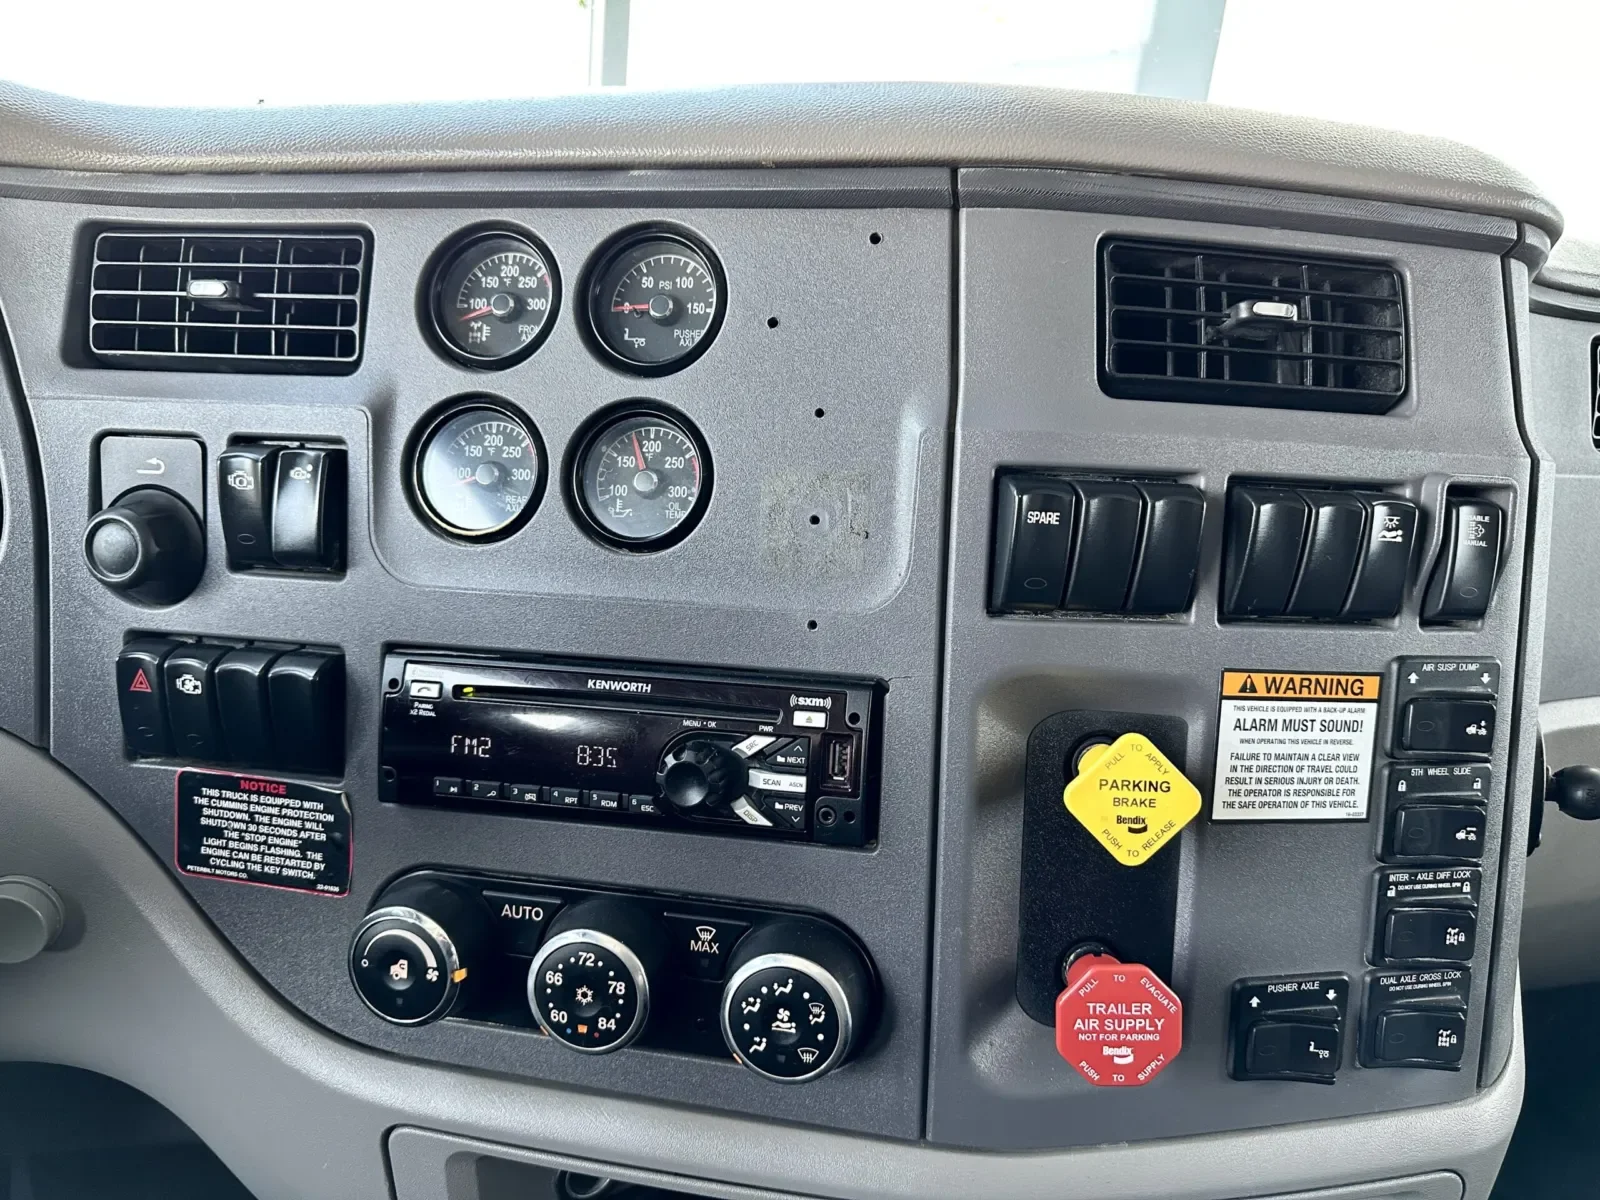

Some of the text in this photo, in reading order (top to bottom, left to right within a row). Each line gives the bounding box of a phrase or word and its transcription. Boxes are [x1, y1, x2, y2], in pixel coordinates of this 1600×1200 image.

[500, 265, 519, 277] 200
[481, 276, 498, 288] 150
[518, 276, 537, 289] 250
[641, 277, 654, 289] 50
[659, 280, 672, 290] PSI
[675, 277, 694, 289] 100
[469, 299, 487, 310] 100
[527, 299, 546, 311] 300
[687, 302, 705, 314] 150
[484, 435, 503, 447] 200
[642, 441, 661, 452] 200
[464, 446, 482, 457] 150
[502, 446, 521, 458] 250
[616, 456, 635, 468] 150
[664, 457, 684, 469] 250
[511, 469, 530, 480] 300
[609, 485, 628, 496] 100
[668, 486, 687, 498] 300
[668, 502, 681, 510] OIL
[1027, 511, 1060, 525] SPARE
[1422, 663, 1480, 672] AIR SUSP DUMP
[587, 679, 651, 693] KENWORTH
[1264, 676, 1365, 696] WARNING
[683, 719, 717, 728] MENU OK
[759, 725, 774, 733] PWR
[1233, 718, 1364, 733] ALARM MUST SOUND!
[451, 735, 492, 758] FM2
[787, 756, 806, 764] NEXT
[1104, 743, 1171, 776] PULL TO APPLY
[1230, 752, 1360, 761] FAILURE TO MAINTAIN CLEAR VIEW
[1230, 764, 1358, 774] IN THE DIRECTION OF TRAVEL COULD
[1411, 767, 1472, 777] 5TH WHEEL SLIDE
[762, 778, 782, 786] SCAN
[1099, 779, 1171, 793] PARKING
[1224, 776, 1360, 785] RESULT IN SERIOUS INJURY OR DEATH.
[240, 780, 287, 795] NOTICE
[1228, 788, 1356, 797] THE OPERATOR IS RESPONSIBLE FOR
[201, 787, 324, 811] THIS TRUCK IS EQUIPPED WITH
[564, 796, 578, 804] RPT
[1112, 797, 1157, 808] BRAKE
[1222, 800, 1359, 809] THE SAFE OPERATION OF THIS VEHICLE.
[193, 796, 335, 822] THE CUMMINS ENGINE PROTECTION
[640, 804, 654, 812] ESC
[784, 803, 804, 811] PREV
[202, 807, 325, 831] SHUTDOWN. THE ENGINE WILL
[1116, 815, 1146, 825] Bendix
[200, 816, 327, 841] SHUTDOWN 30 SECONDS AFTER
[223, 830, 240, 839] THE
[1101, 819, 1177, 858] PUSH TO RELEASE
[203, 836, 324, 861] LIGHT BEGINS FLASHING. THE
[200, 846, 326, 871] ENGINE CAN BE RESTARTED BY
[187, 864, 215, 874] PETERBILT
[209, 857, 316, 880] CYCLING THE KEY SWITCH.
[1389, 870, 1472, 882] INTER AXLE DIFF LOCK
[501, 903, 544, 921] AUTO
[690, 940, 719, 954] MAX
[578, 952, 594, 966] 72
[545, 971, 563, 986] 66
[1380, 971, 1462, 985] DUAL AXLE CROSS LOCK
[607, 981, 625, 995] 78
[1267, 981, 1320, 993] PUSHER AXLE
[1078, 974, 1178, 1014] PULL TO EVACUATE
[1087, 1002, 1152, 1015] TRAILER
[550, 1009, 568, 1023] 60
[597, 1017, 616, 1031] 84
[1073, 1018, 1165, 1031] AIR SUPPLY
[1078, 1033, 1160, 1041] NOT FOR PARKING
[1102, 1045, 1133, 1056] Bendix
[1079, 1053, 1166, 1082] PUSH TO SUPPLY
